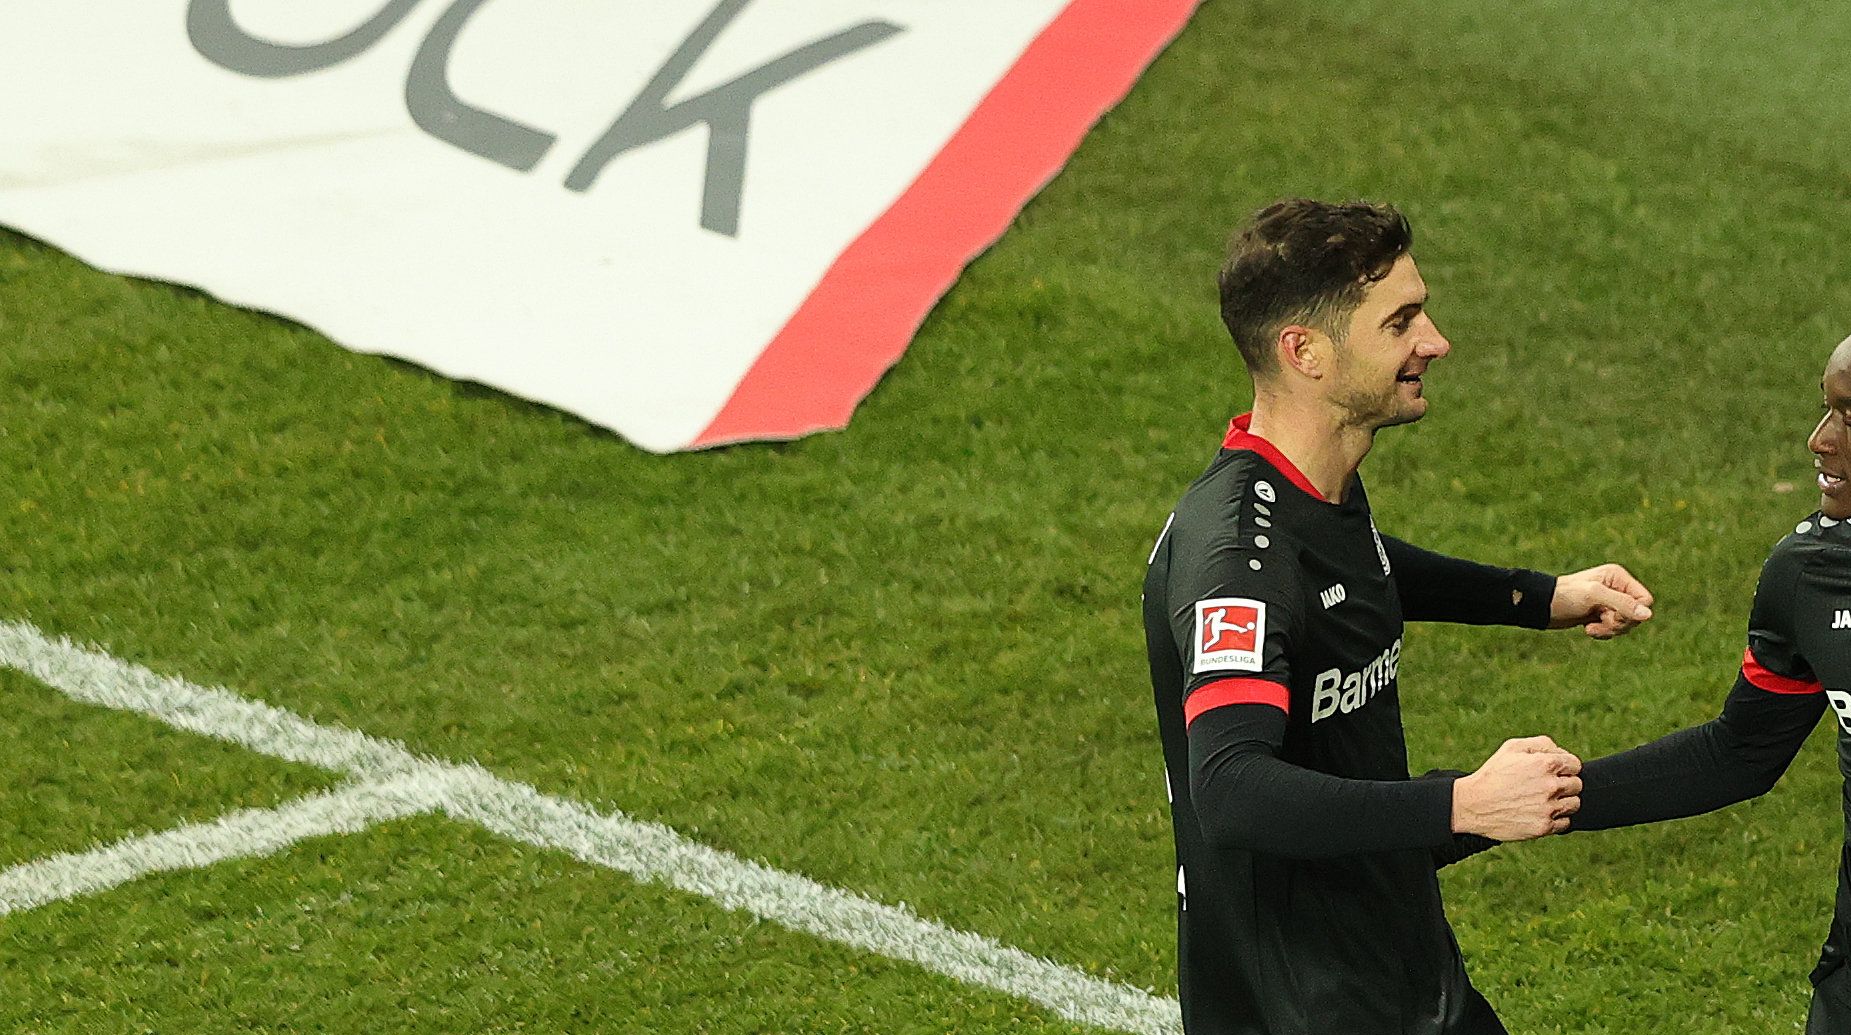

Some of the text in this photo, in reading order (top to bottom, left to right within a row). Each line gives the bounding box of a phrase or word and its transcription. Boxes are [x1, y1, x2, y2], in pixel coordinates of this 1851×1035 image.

[1320, 583, 1346, 609] JAKO
[1200, 655, 1256, 665] BUNDESLIGA
[1312, 639, 1401, 723] Barme
